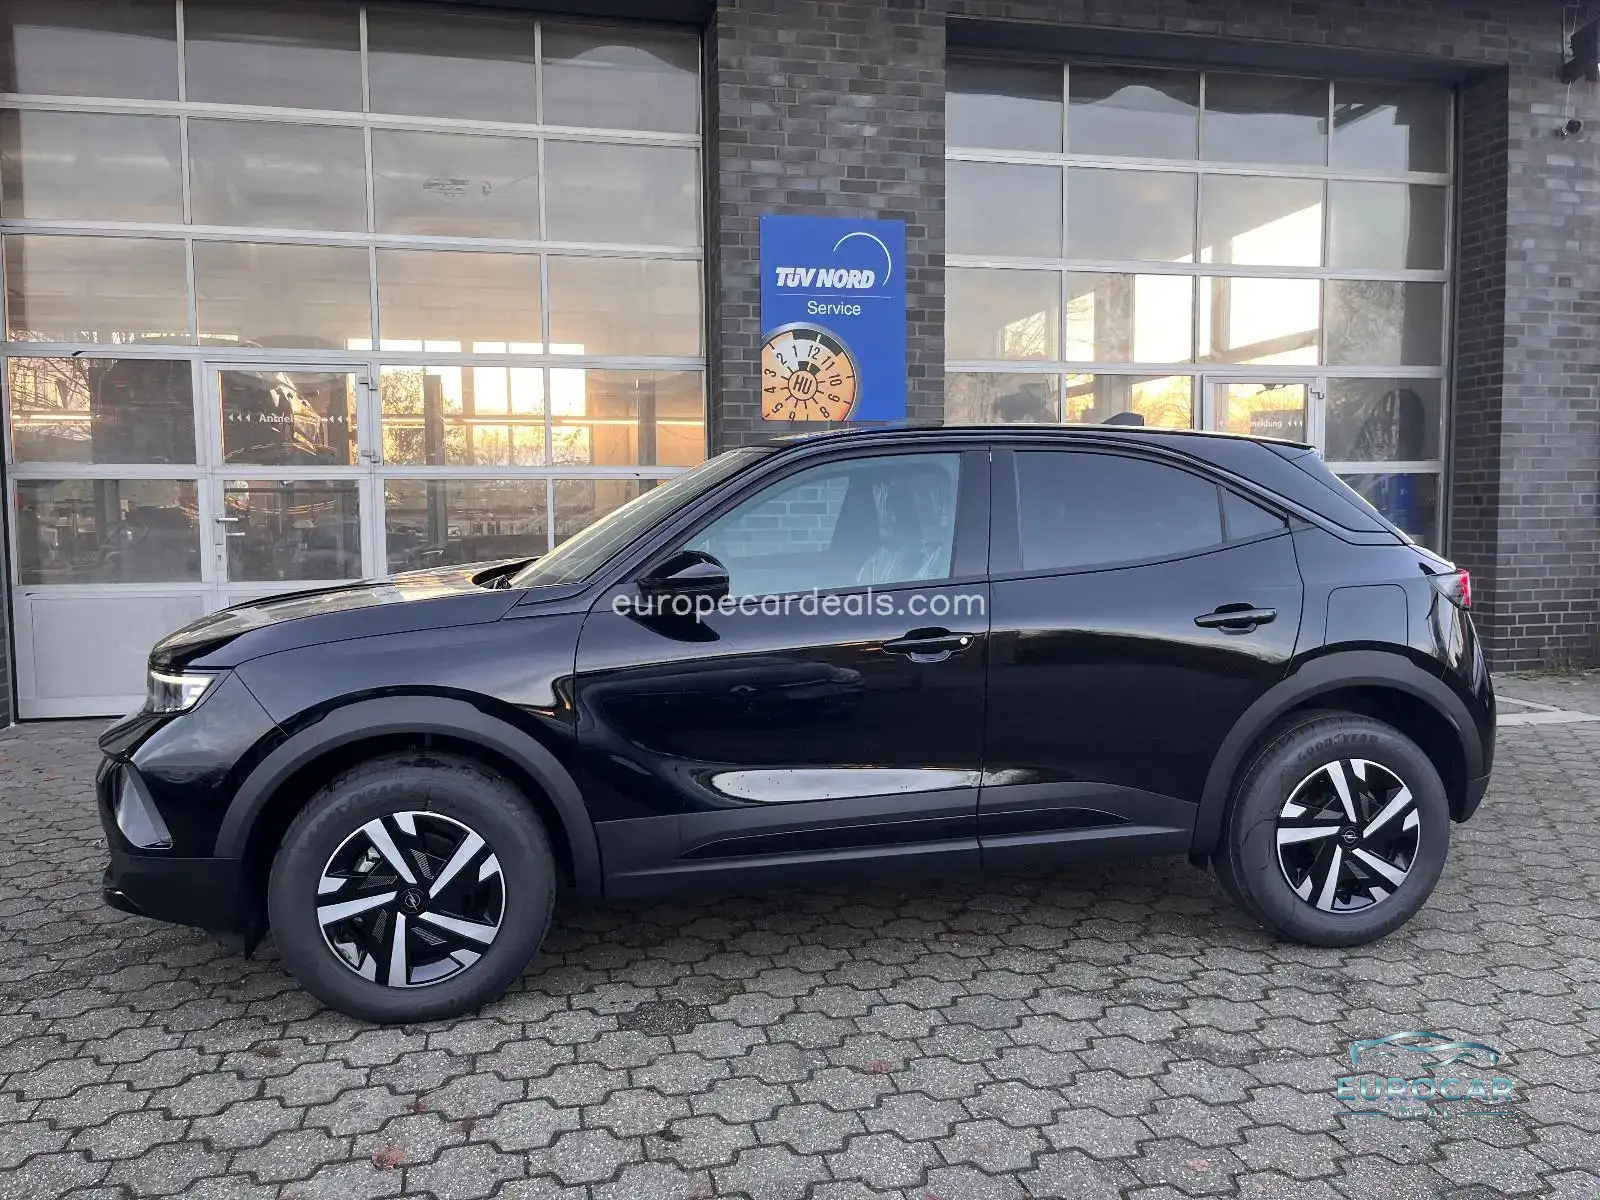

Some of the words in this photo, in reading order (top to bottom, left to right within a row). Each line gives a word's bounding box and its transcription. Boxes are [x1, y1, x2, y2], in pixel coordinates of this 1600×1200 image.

[776, 267, 816, 288] TÜV
[815, 268, 875, 289] NORD
[807, 300, 861, 316] Service
[792, 345, 798, 358] 1
[807, 345, 820, 360] 12
[776, 352, 787, 365] 2
[821, 356, 835, 371] 11
[764, 368, 777, 377] 3
[793, 375, 812, 394] HU
[828, 374, 843, 386] 10
[772, 402, 784, 413] 5
[820, 406, 830, 419] 8
